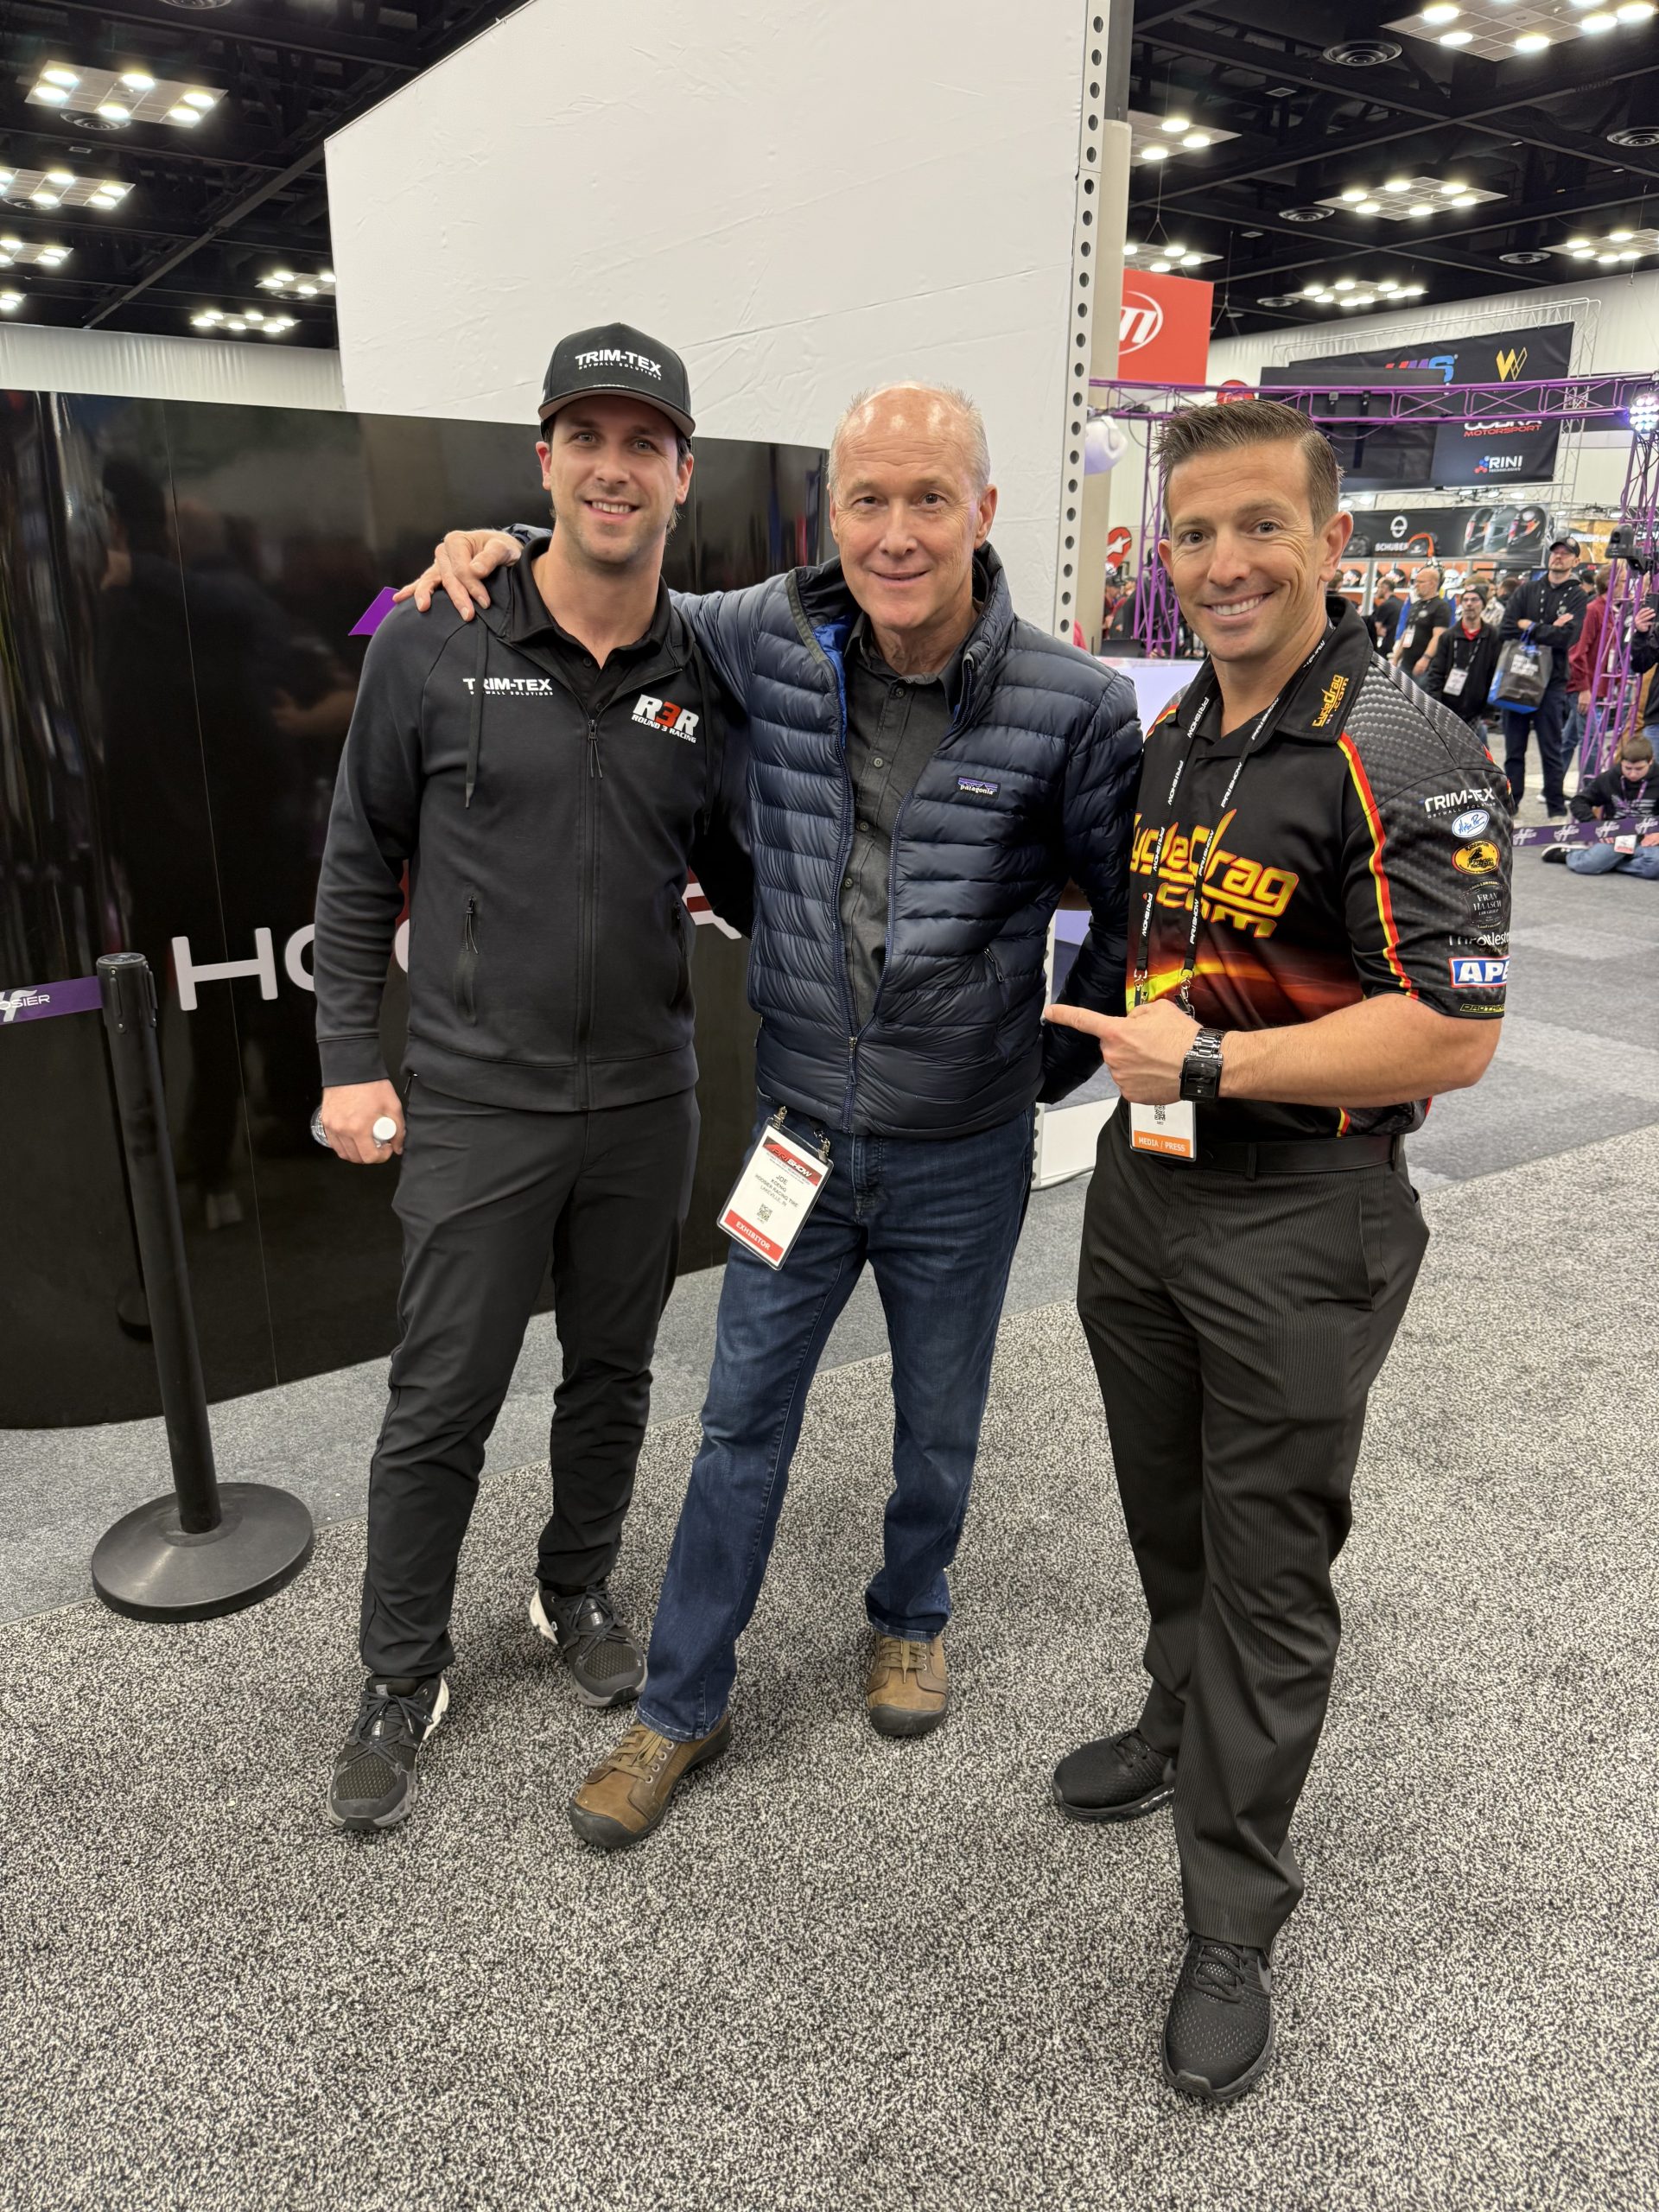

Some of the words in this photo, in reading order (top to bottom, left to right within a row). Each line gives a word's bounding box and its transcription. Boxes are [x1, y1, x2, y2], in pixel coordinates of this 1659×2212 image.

[575, 349, 662, 377] TRIM-TEX
[1463, 424, 1541, 437] MOTORSPORT
[1488, 455, 1522, 468] RINI
[462, 677, 553, 691] TRIM-TEX
[631, 714, 661, 729] ROUND
[669, 728, 696, 744] RACING
[632, 694, 699, 736] R3R
[1187, 696, 1210, 739] PRISHOW
[960, 785, 994, 795] patagonia
[1167, 760, 1184, 805] PRISHOW
[1220, 762, 1243, 808] PRISHOW
[1425, 787, 1496, 812] TRIM-TEX
[1129, 808, 1300, 917] ycleDrag
[1153, 826, 1166, 872] PRISHOW
[1198, 829, 1214, 876] PRISHOW
[1477, 892, 1498, 902] FRAN
[1189, 899, 1199, 944] PRISHOW
[1138, 1136, 1159, 1147] MEDIA
[1165, 1141, 1185, 1152] PRESS
[775, 1174, 788, 1185] JOE
[735, 1220, 772, 1251] EXHIBITOR
